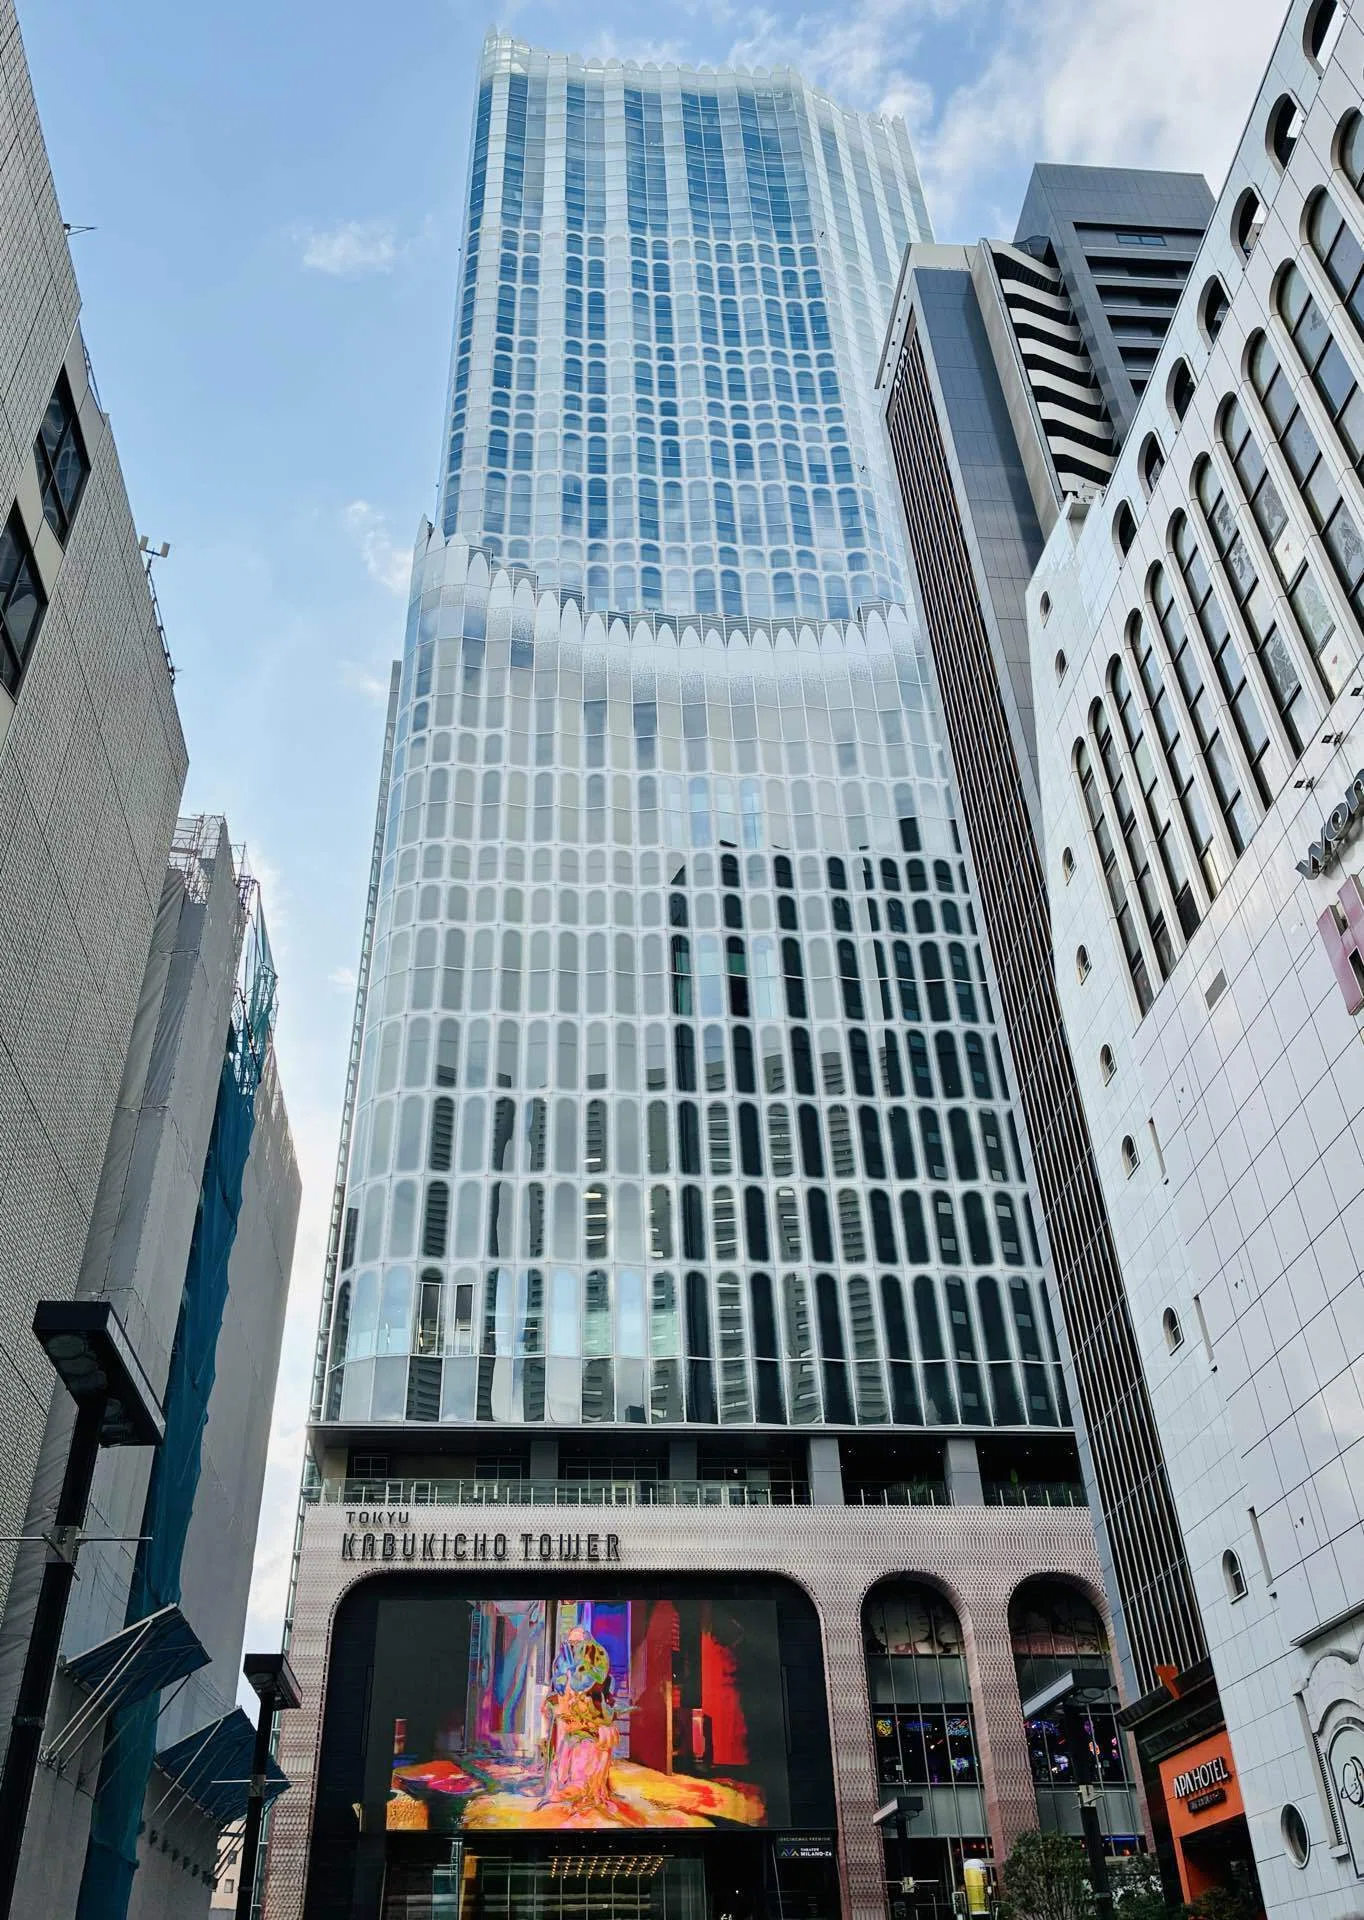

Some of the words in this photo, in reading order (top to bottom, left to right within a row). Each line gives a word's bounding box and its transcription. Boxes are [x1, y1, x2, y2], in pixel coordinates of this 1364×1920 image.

[346, 1511, 410, 1524] TOKYU
[342, 1532, 508, 1560] KABUKICHO
[521, 1533, 621, 1561] TOWER
[1173, 1772, 1195, 1799] APA
[1191, 1757, 1229, 1791] HOTEL
